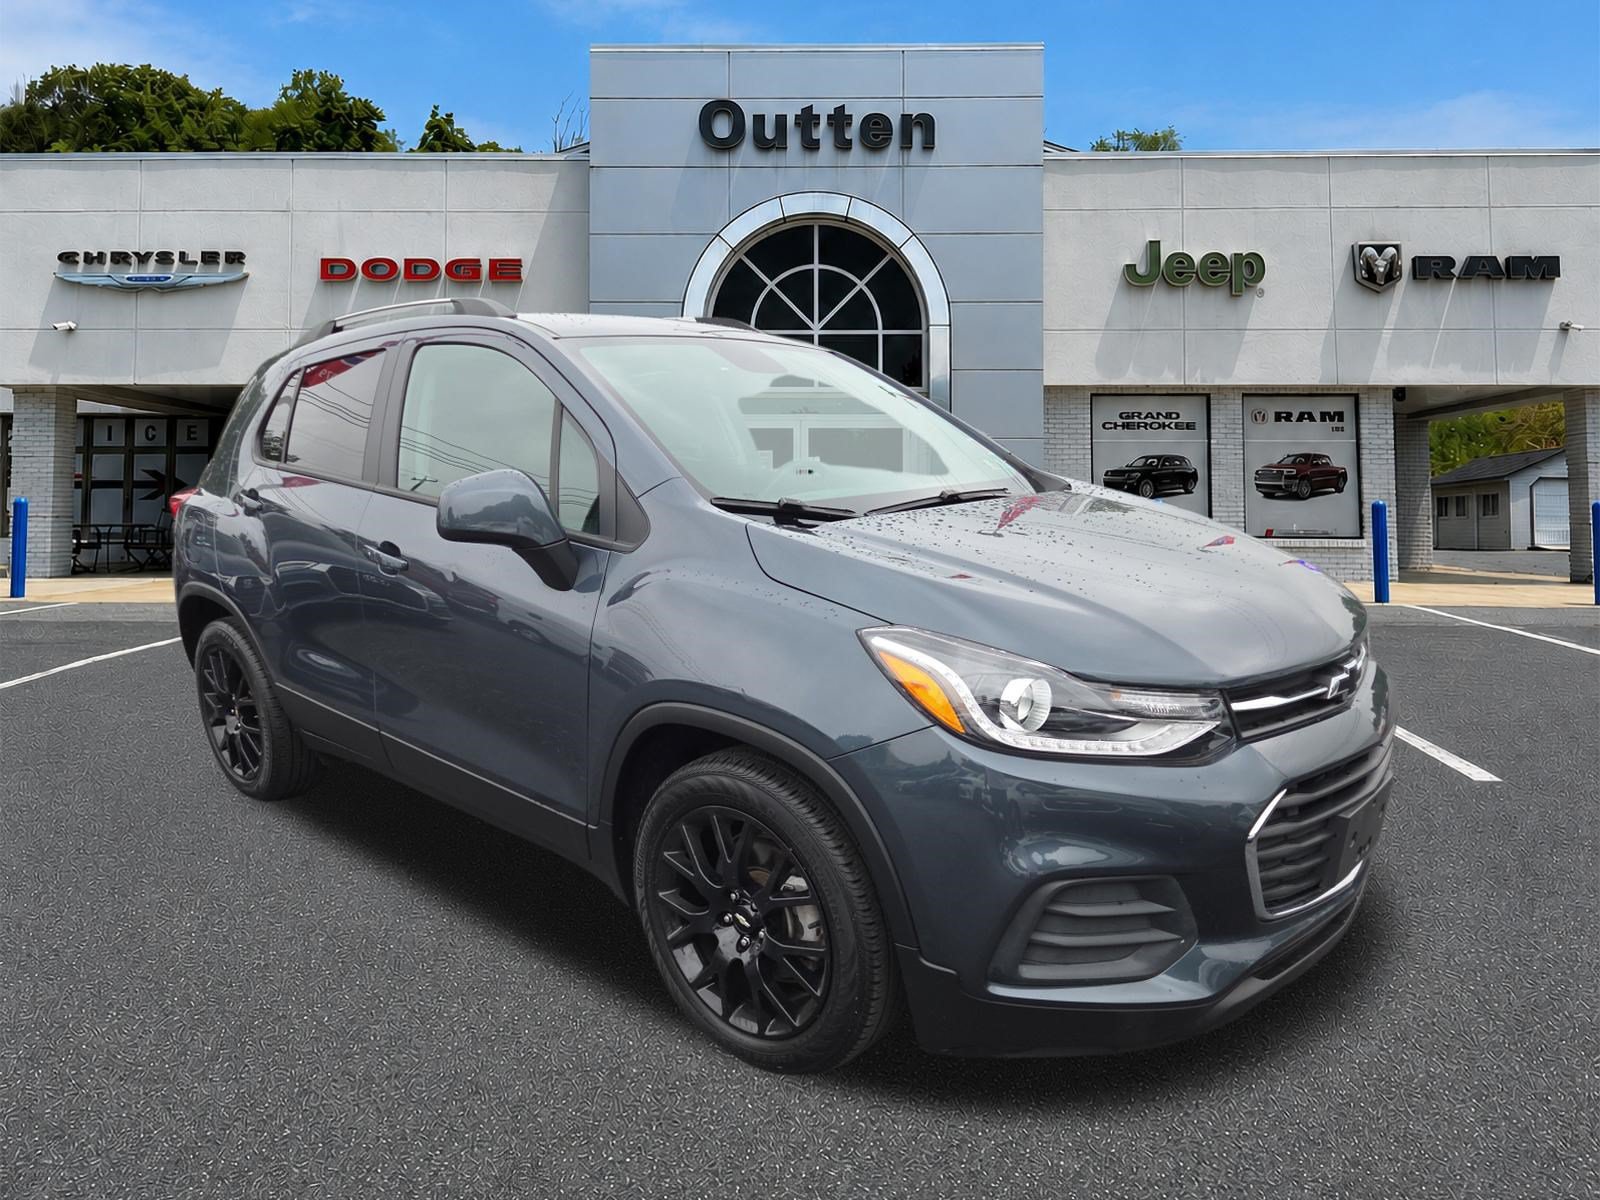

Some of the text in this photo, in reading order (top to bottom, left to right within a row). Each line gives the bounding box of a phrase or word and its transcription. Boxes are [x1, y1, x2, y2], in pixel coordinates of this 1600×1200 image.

[700, 99, 936, 151] Outten
[57, 250, 247, 266] CHRYSLER
[1124, 239, 1266, 297] Jeep
[1411, 255, 1561, 280] RAM
[320, 257, 523, 283] DODGE
[1101, 421, 1197, 431] CHEROKEE
[1118, 411, 1181, 421] GRAND
[1274, 411, 1345, 423] RAM
